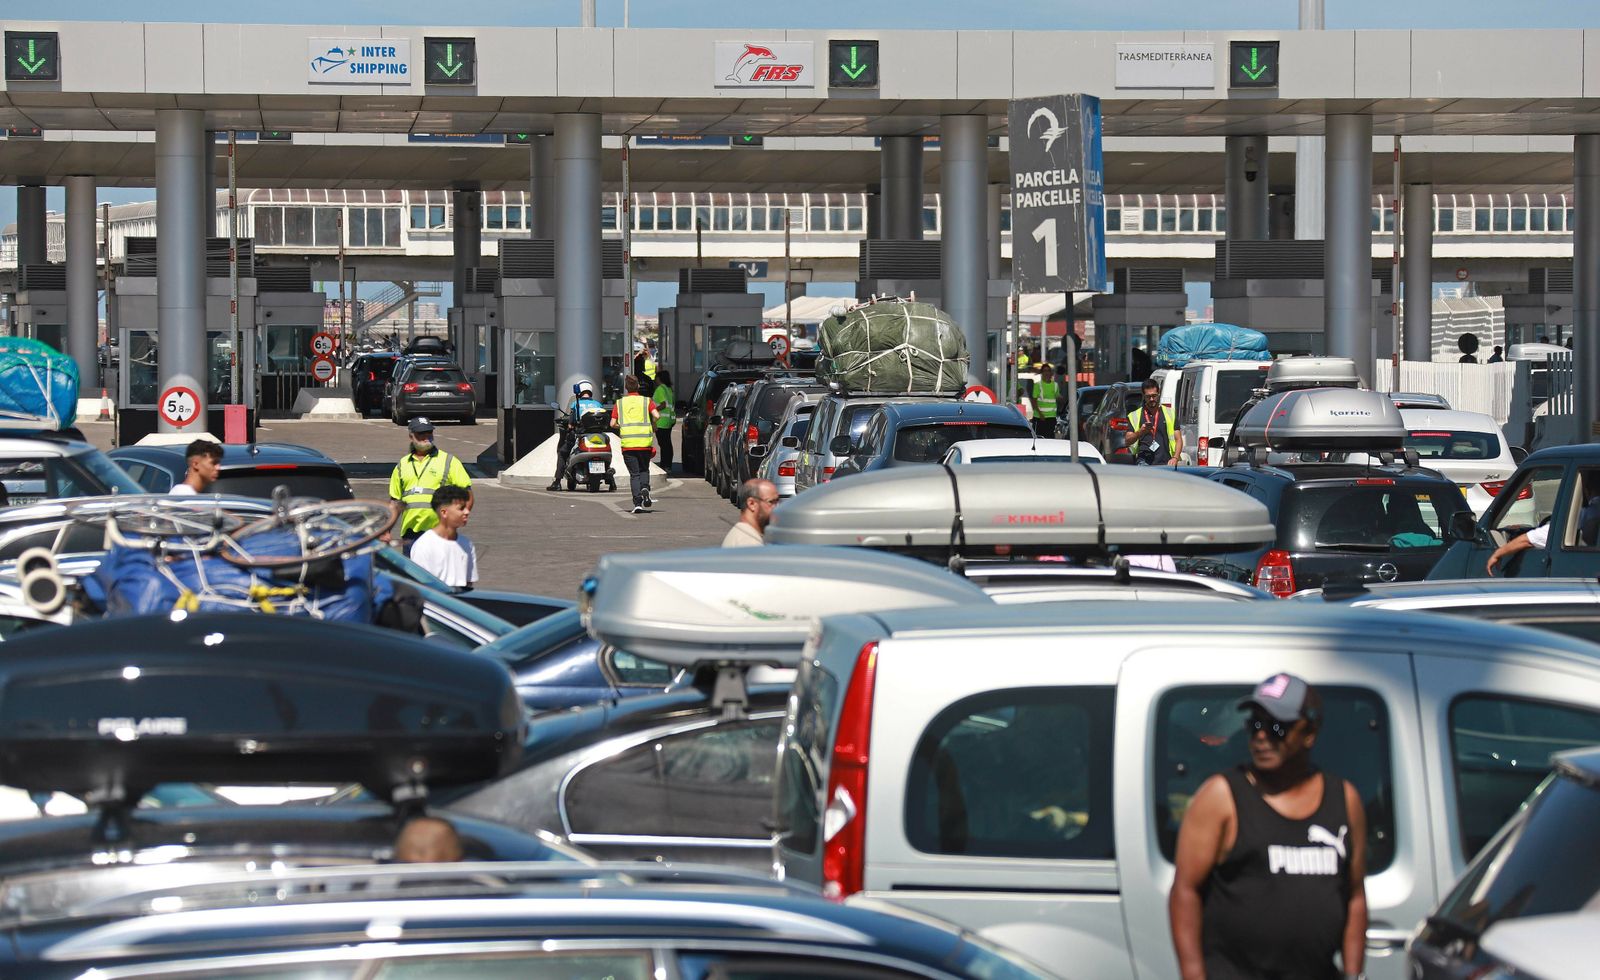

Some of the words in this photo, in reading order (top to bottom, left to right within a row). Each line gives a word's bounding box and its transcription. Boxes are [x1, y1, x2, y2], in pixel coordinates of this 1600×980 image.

[361, 46, 396, 57] INTER
[1118, 52, 1213, 61] TRASMEDITERRANEA
[350, 63, 408, 74] SHIPPING
[749, 64, 804, 81] FRS
[1015, 168, 1080, 188] PARCELA
[1016, 188, 1081, 208] PARCELLE
[1031, 218, 1058, 276] 1
[1267, 845, 1338, 875] PUMA
